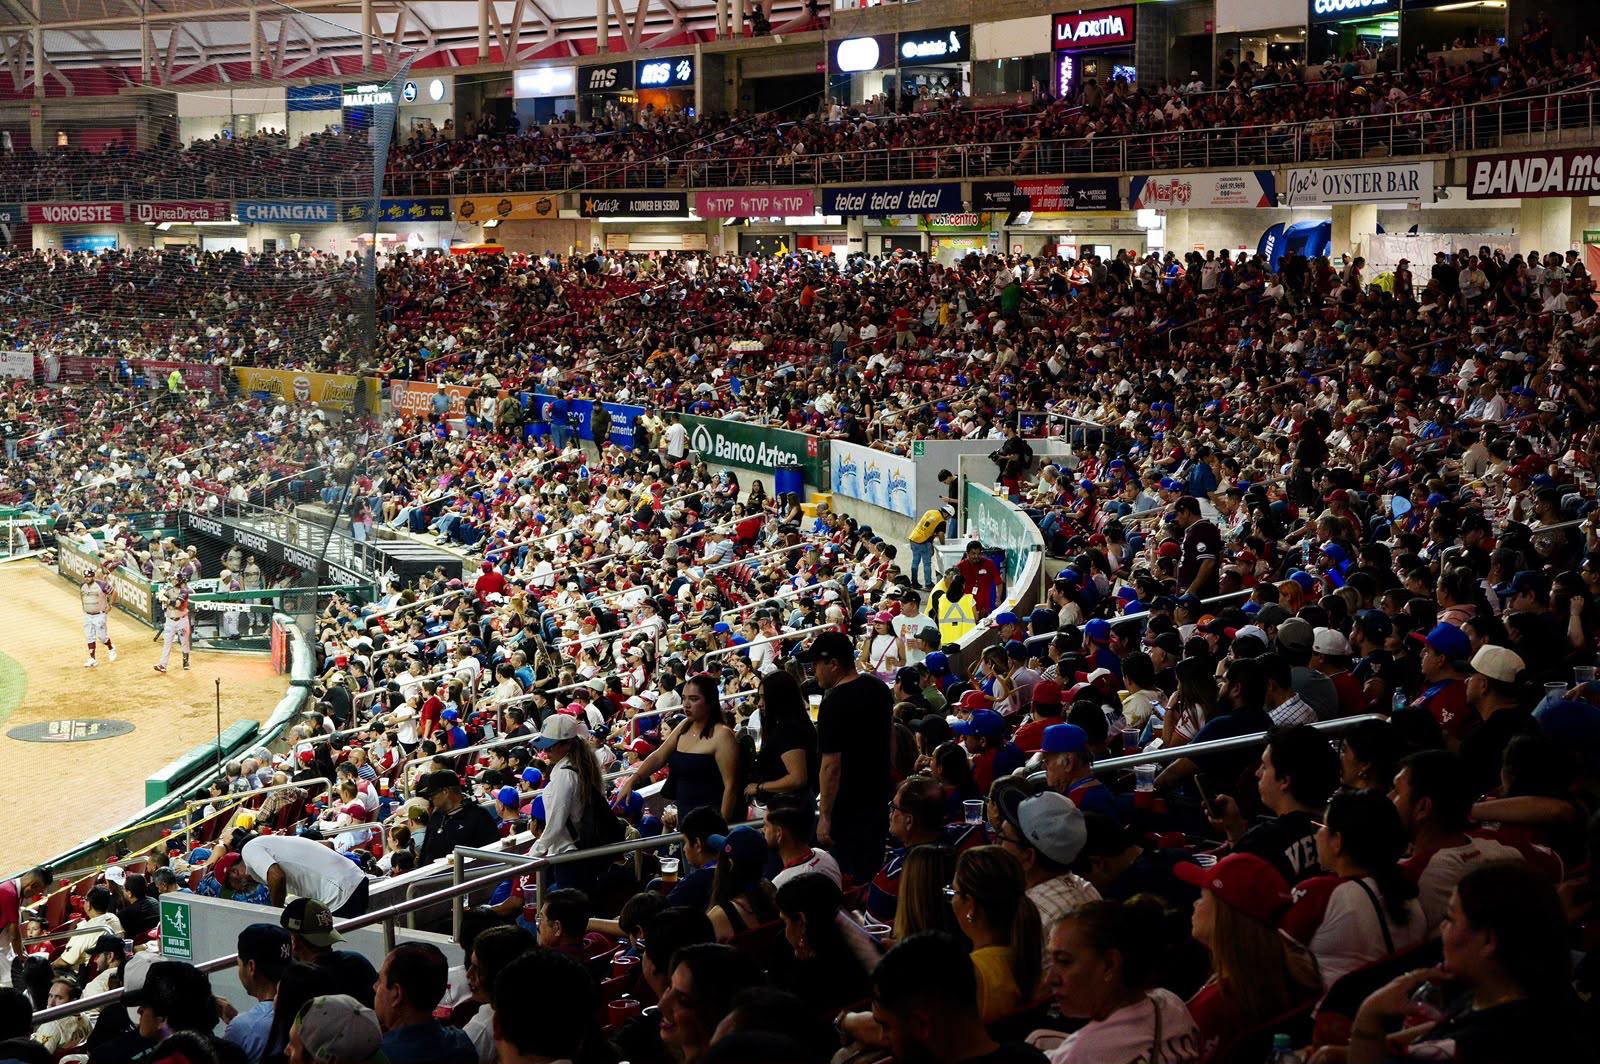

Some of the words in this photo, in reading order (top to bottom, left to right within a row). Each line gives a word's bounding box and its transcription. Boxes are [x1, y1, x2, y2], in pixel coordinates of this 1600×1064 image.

[1058, 24, 1072, 40] LA
[1472, 156, 1563, 195] BANDA
[1289, 169, 1318, 205] Joe's
[1323, 172, 1382, 195] OYSTER
[1387, 170, 1420, 191] BAR
[629, 201, 634, 211] A
[635, 201, 654, 211] COMER
[655, 201, 662, 211] EN
[663, 200, 680, 211] SERIO
[716, 198, 734, 212] TVP
[751, 198, 769, 212] TVP
[784, 197, 803, 211] TVP
[835, 193, 866, 211] telcel
[870, 191, 903, 210] telcel
[907, 189, 942, 208] telcel
[42, 206, 112, 222] NOROESTE
[246, 205, 328, 219] CHANGAN
[715, 434, 754, 463] Banco
[756, 441, 799, 467] Azteca
[188, 515, 222, 537] POWERADE
[233, 529, 268, 553] POWERADE
[283, 547, 317, 572] POWERADE
[328, 565, 360, 587] POWERADE
[194, 601, 251, 612] POWERADE
